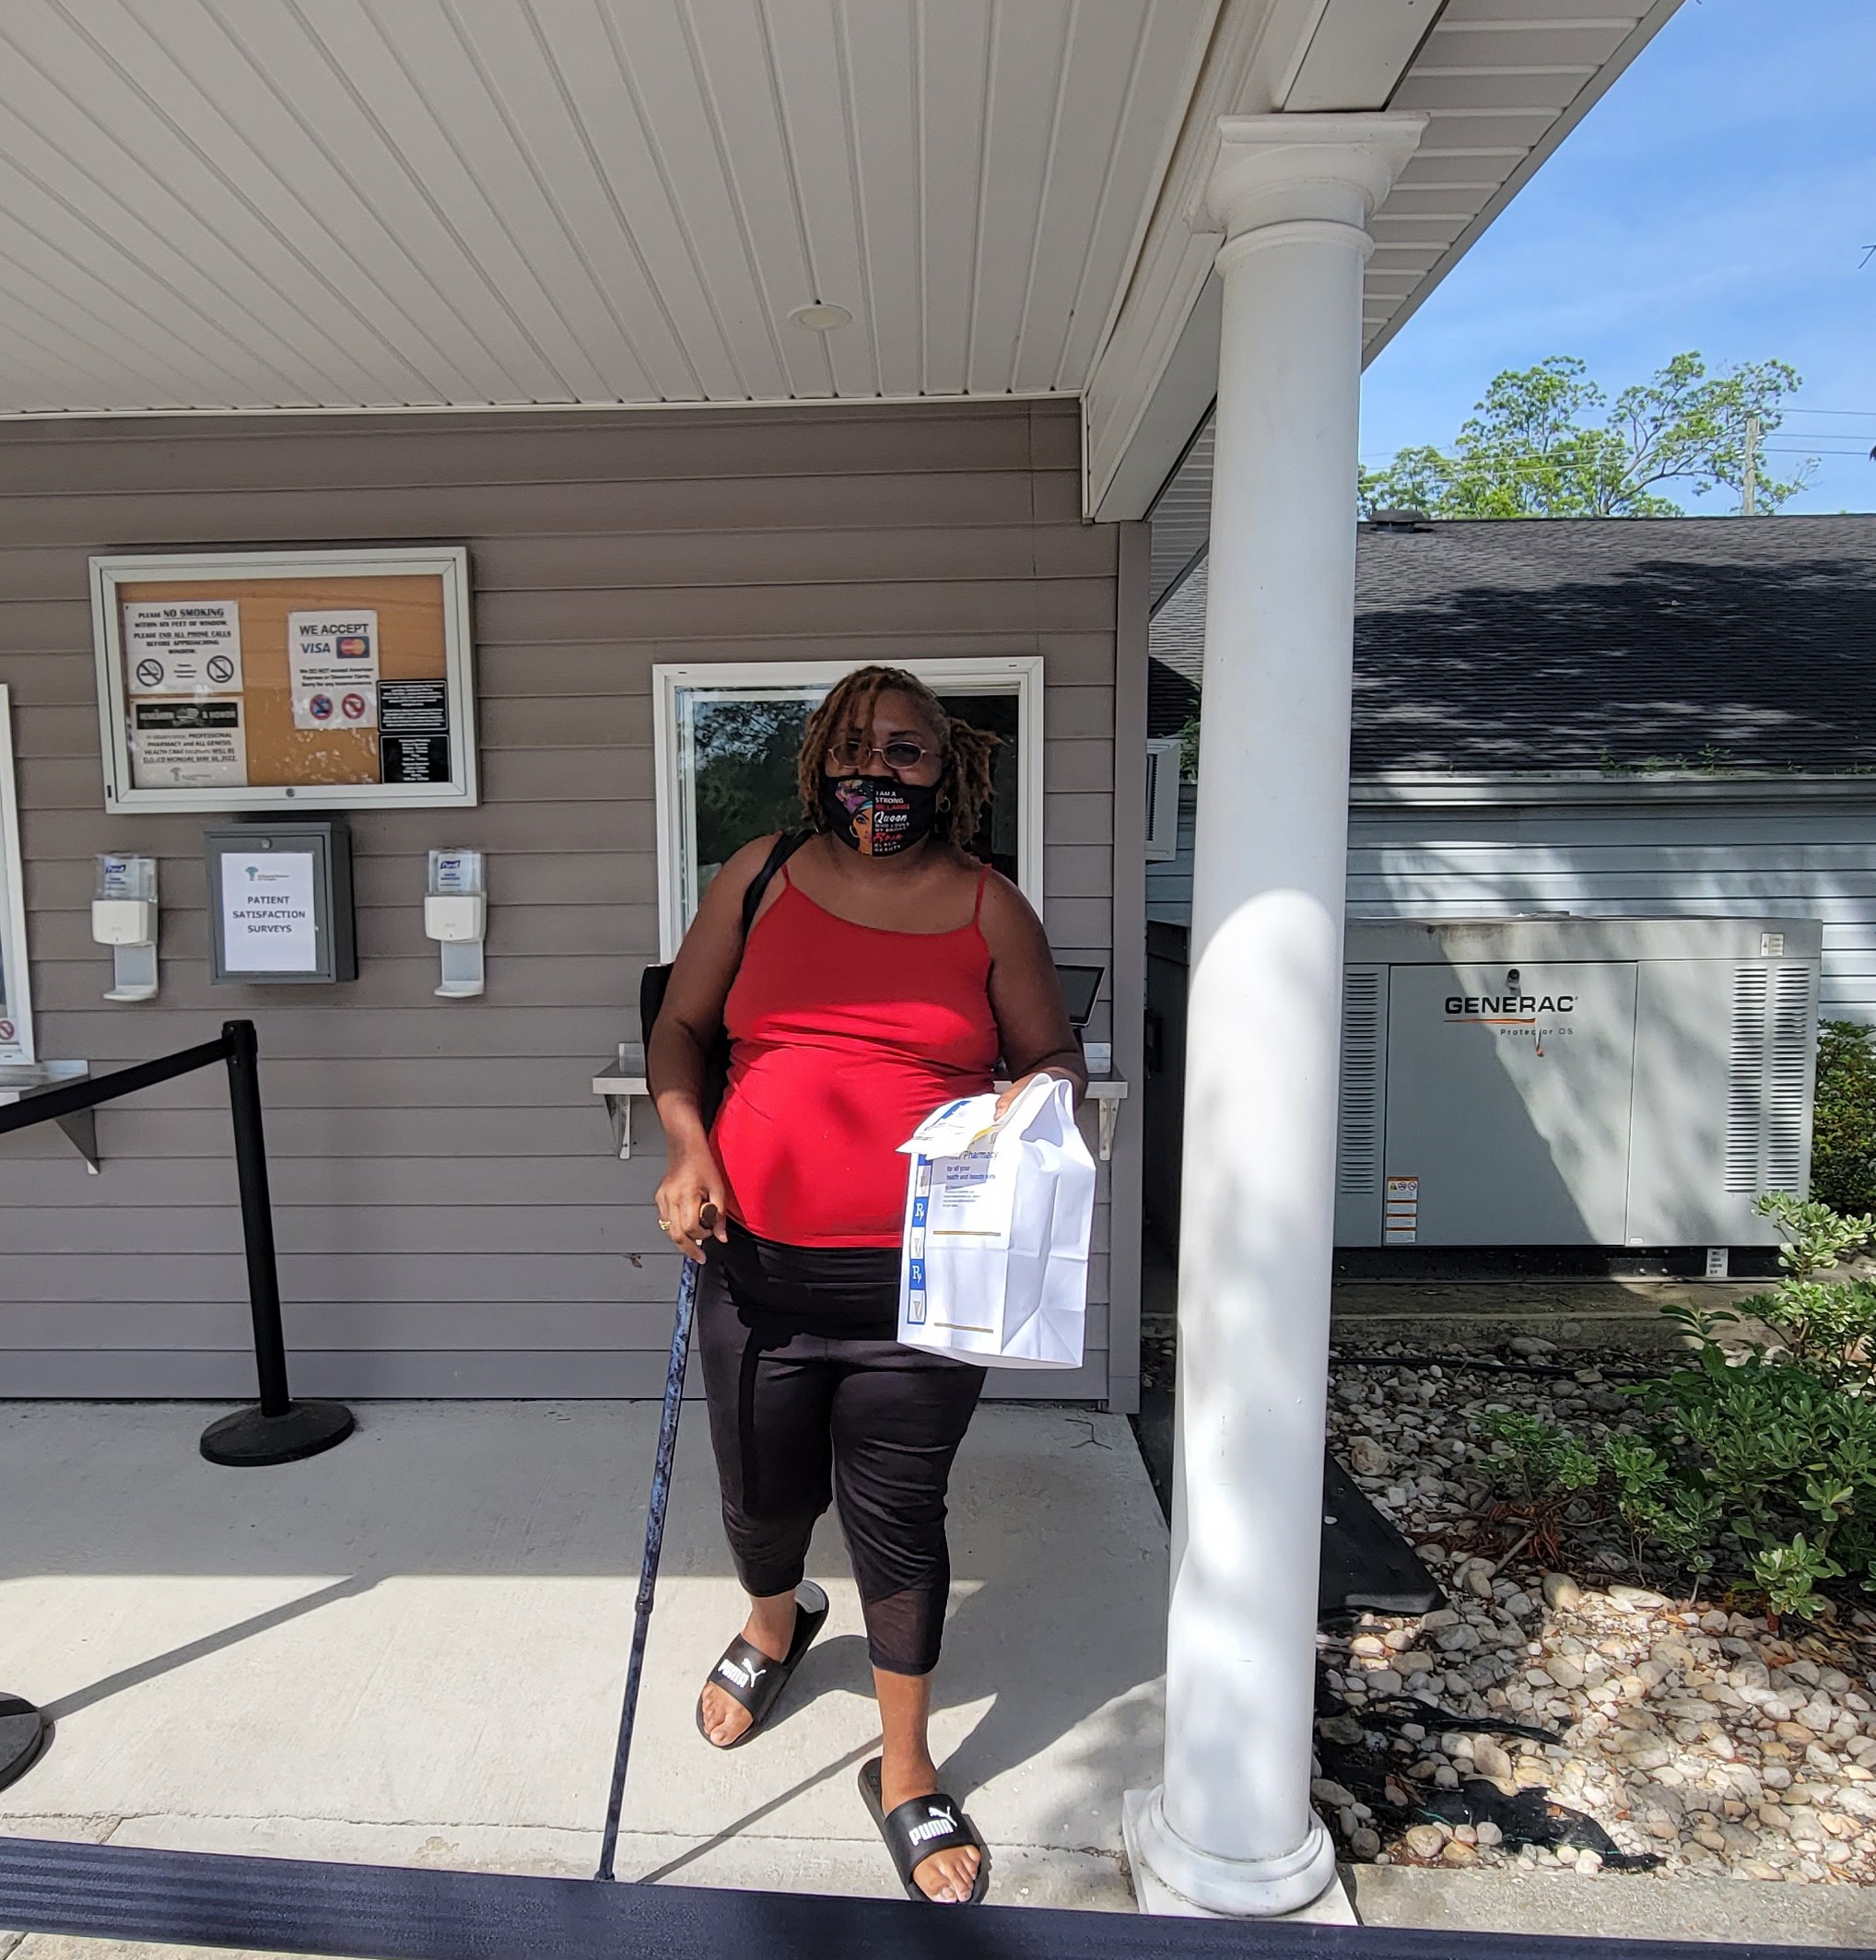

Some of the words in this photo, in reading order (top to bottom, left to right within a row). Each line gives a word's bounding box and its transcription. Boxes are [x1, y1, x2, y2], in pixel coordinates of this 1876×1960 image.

[164, 609, 177, 617] NO
[180, 608, 224, 617] SMOKING
[299, 625, 318, 635] WE
[321, 623, 369, 634] ACCEPT
[300, 642, 331, 653] VISA
[874, 811, 908, 824] Queen
[247, 896, 290, 904] PATIENT
[232, 910, 306, 919] SATISFACTION
[247, 924, 292, 933] SURVEYS
[1445, 995, 1574, 1014] GENERAC
[718, 1659, 750, 1688] PUMA
[909, 1818, 955, 1847] PUMA
